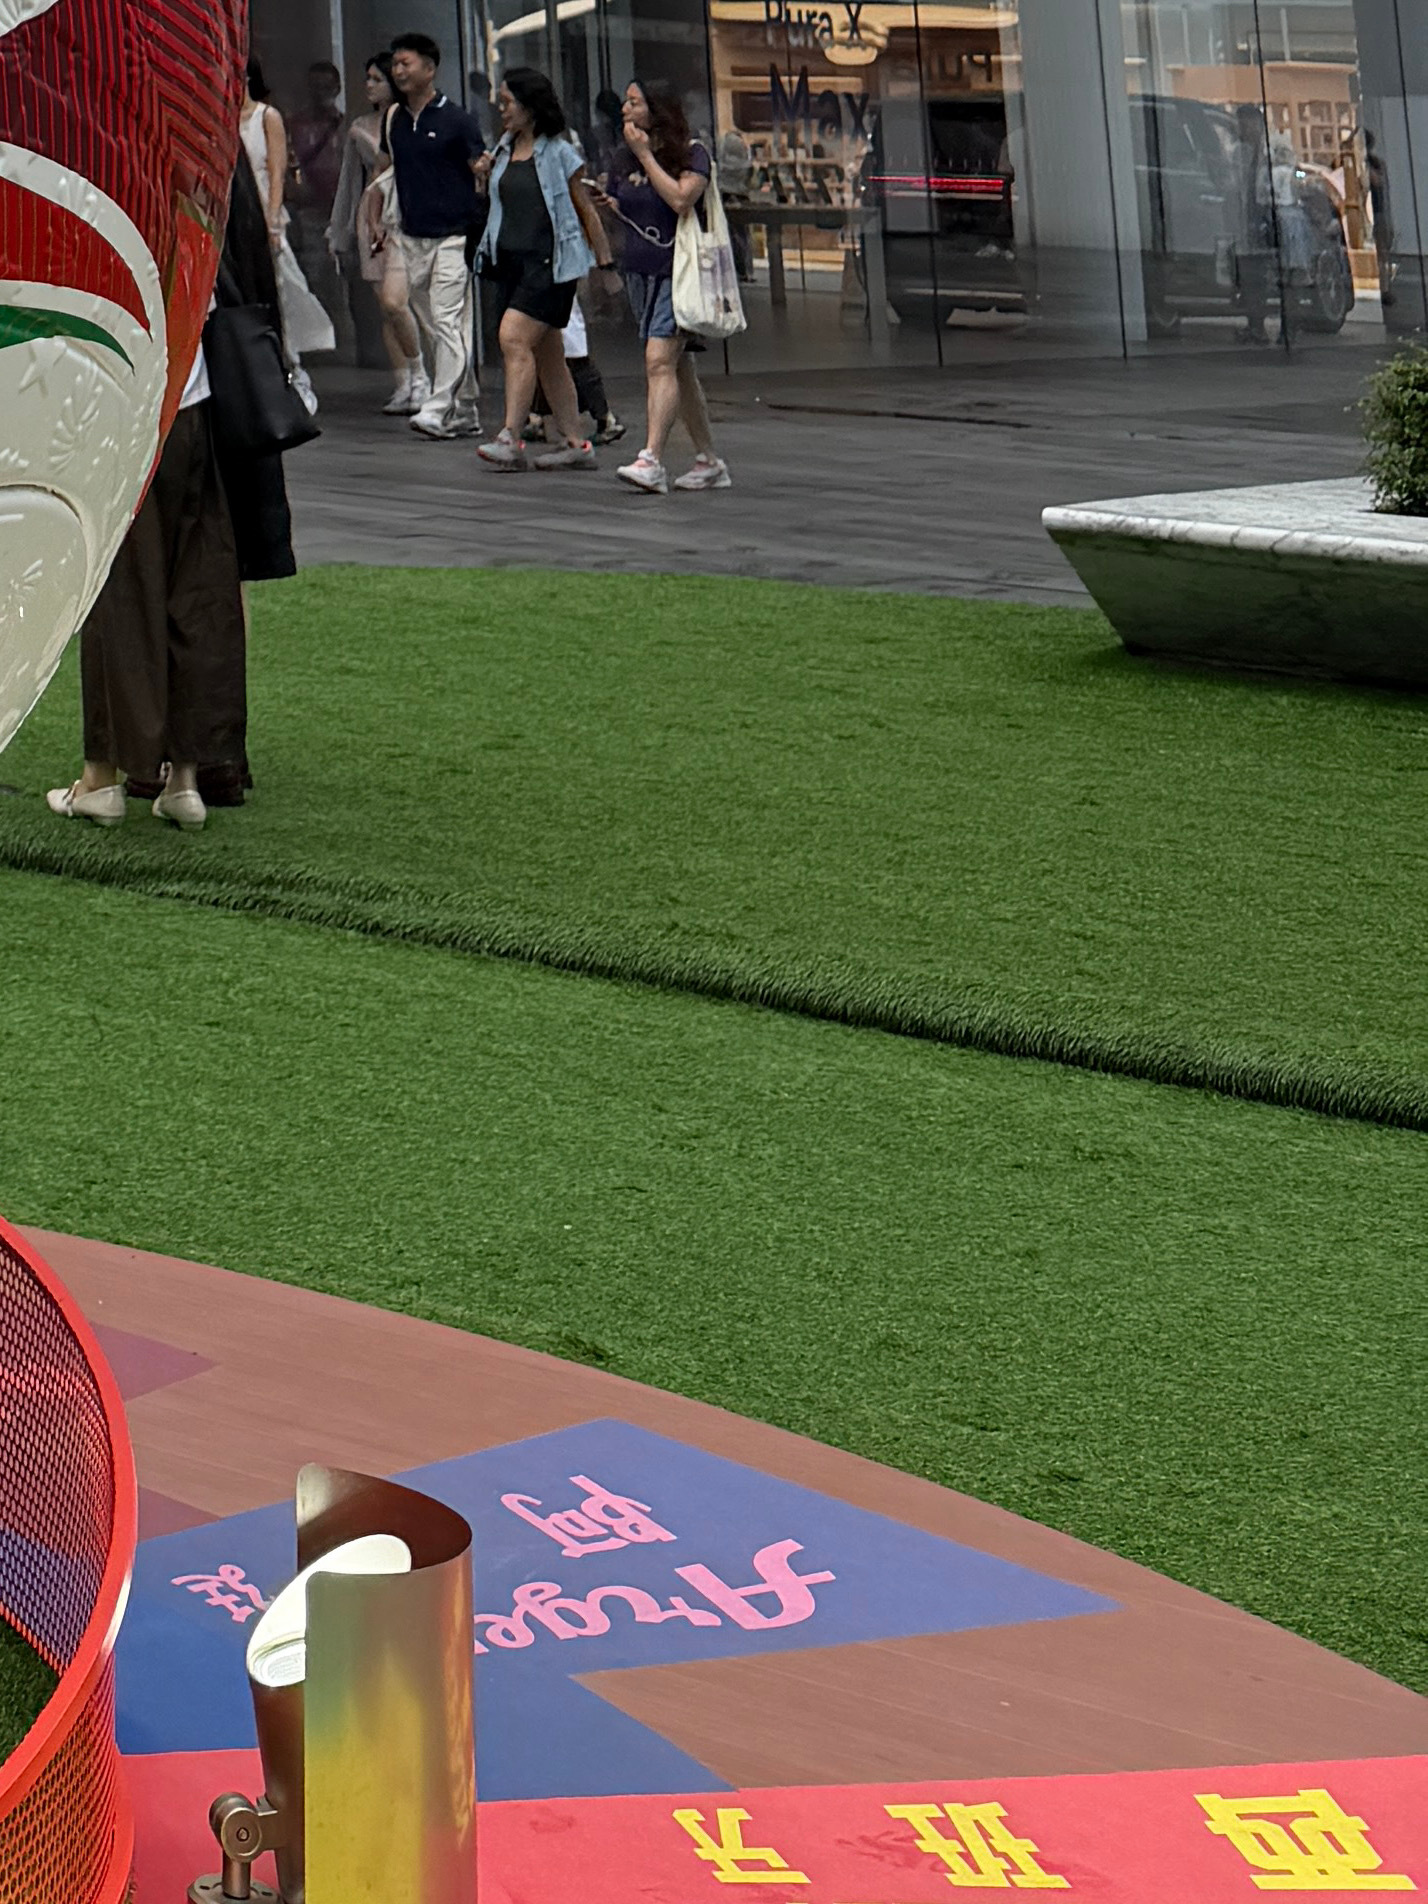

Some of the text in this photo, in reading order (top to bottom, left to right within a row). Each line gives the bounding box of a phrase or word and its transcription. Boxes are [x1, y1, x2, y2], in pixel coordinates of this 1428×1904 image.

[764, 1, 864, 48] Pura X
[769, 63, 872, 144] Max
[474, 1538, 836, 1654] Arge
